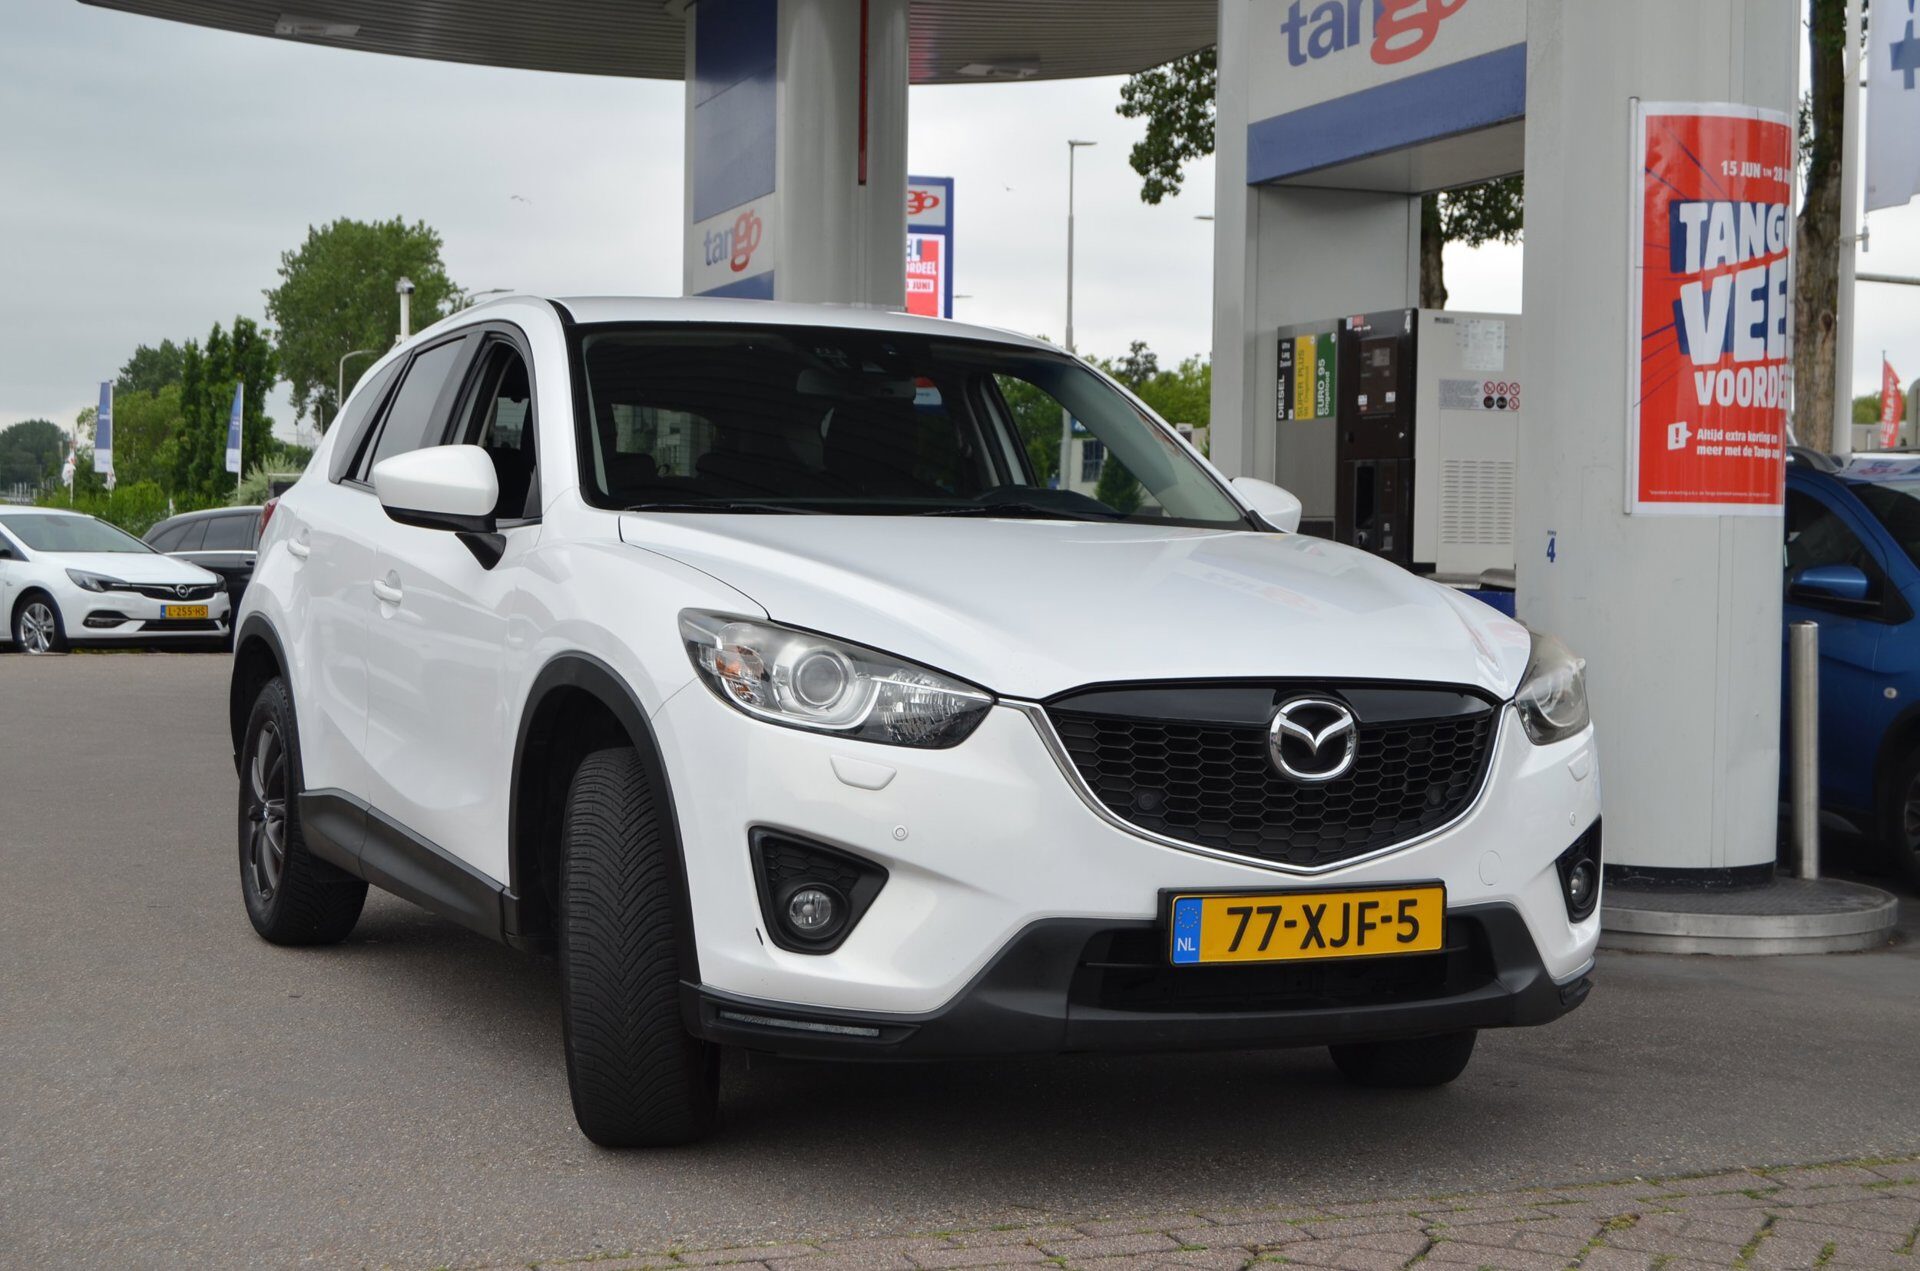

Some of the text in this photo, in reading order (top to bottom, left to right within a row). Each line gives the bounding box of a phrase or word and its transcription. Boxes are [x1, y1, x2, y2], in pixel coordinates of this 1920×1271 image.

[1721, 160, 1737, 176] 15
[1740, 161, 1761, 178] JUN
[704, 207, 762, 272] tango
[912, 281, 931, 290] JUNI
[1404, 315, 1411, 334] 4
[1318, 359, 1325, 376] 95
[1697, 429, 1723, 442] Altijd
[1725, 431, 1746, 442] extra
[1748, 431, 1770, 444] korting
[1697, 445, 1723, 456] meer
[1725, 446, 1741, 456] met
[1742, 445, 1752, 457] de
[1547, 537, 1556, 563] 4
[1227, 898, 1420, 952] 77-XJF-5
[1177, 937, 1196, 952] NL
